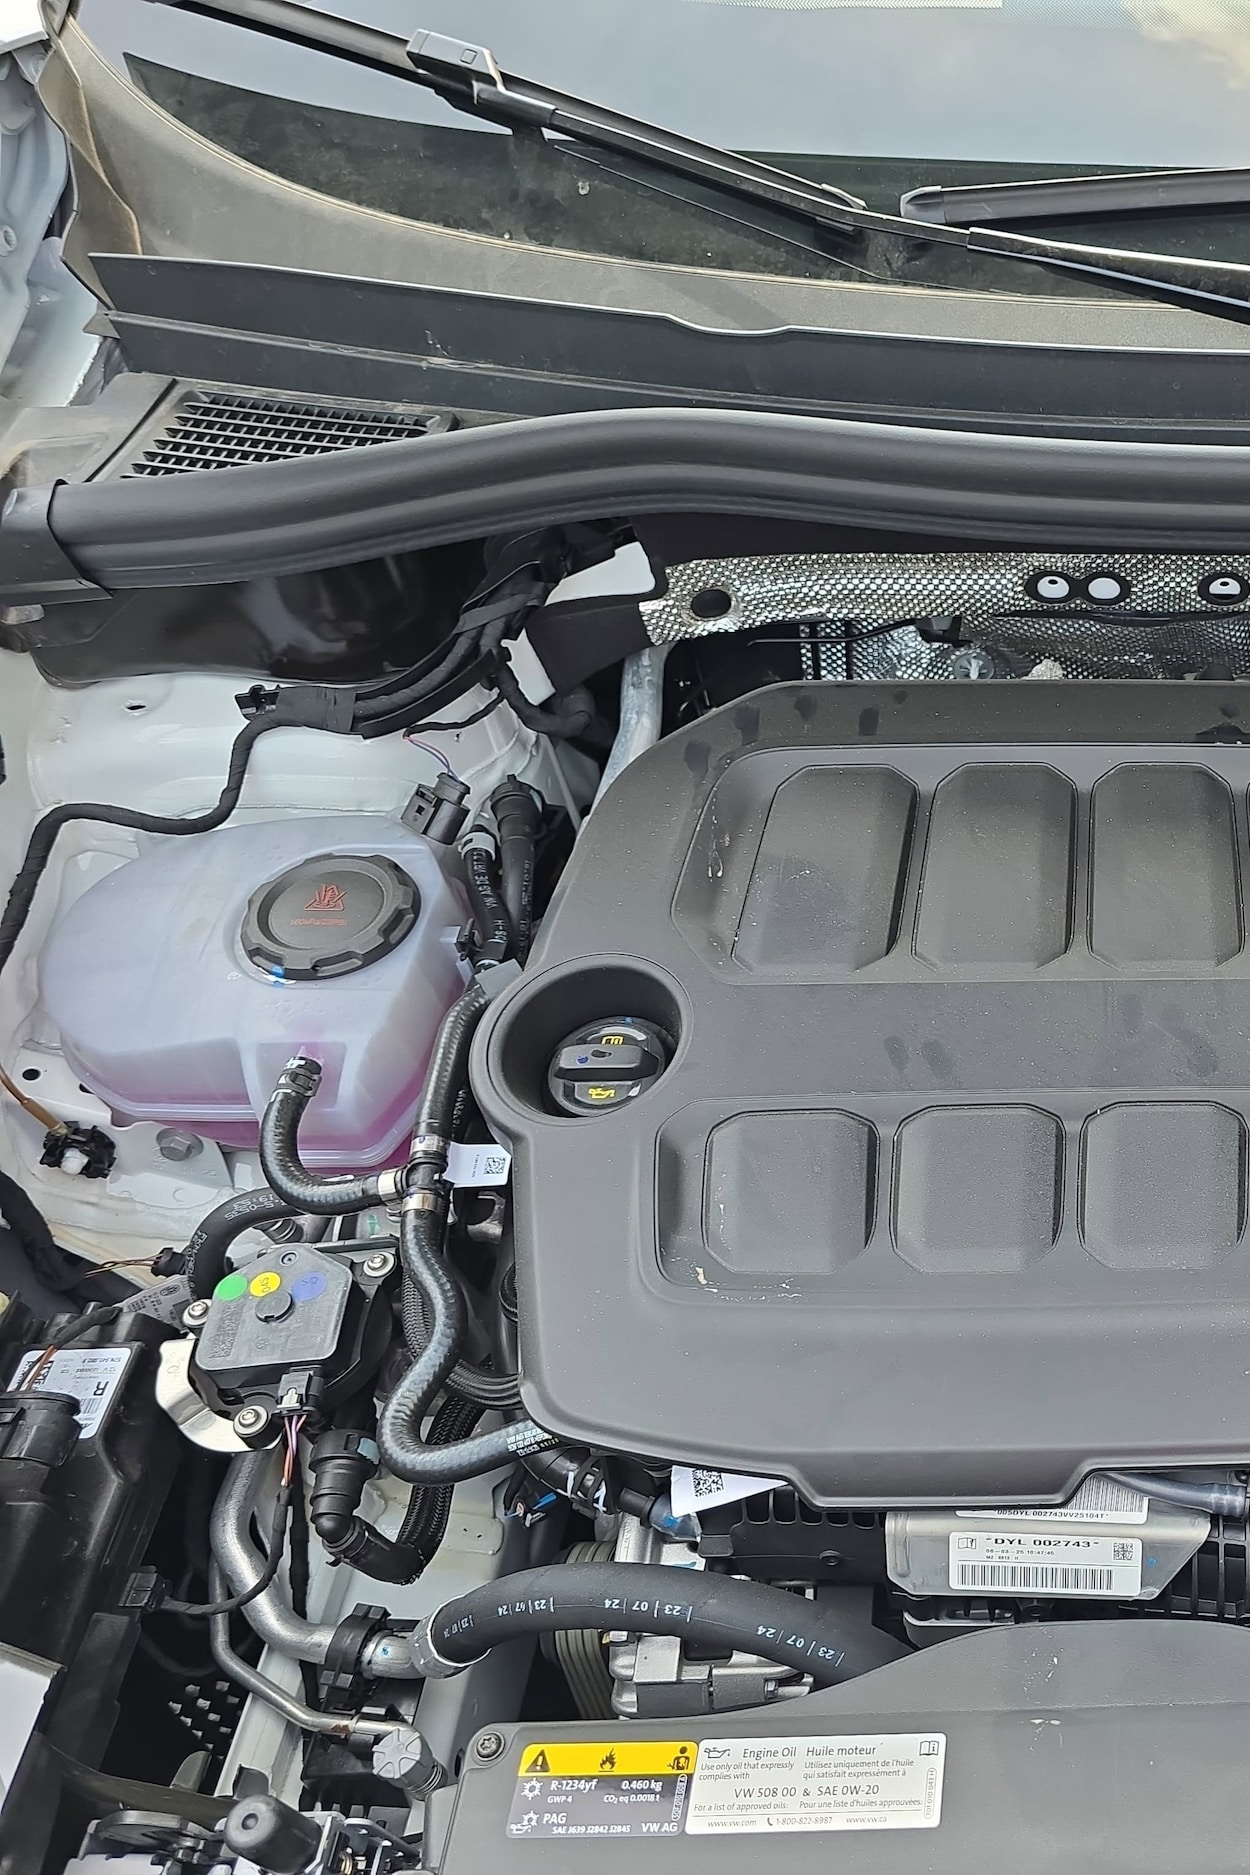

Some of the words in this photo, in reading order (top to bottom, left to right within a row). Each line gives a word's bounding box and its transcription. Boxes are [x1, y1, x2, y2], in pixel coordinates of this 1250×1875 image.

[93, 1381, 109, 1396] R
[534, 1599, 546, 1609] 23
[604, 1597, 620, 1610] 24
[632, 1600, 649, 1612] 07
[664, 1604, 682, 1616] 23
[756, 1624, 776, 1638] 24
[786, 1634, 805, 1648] 07
[817, 1645, 836, 1660] 23
[743, 1747, 779, 1761] Engine
[782, 1747, 796, 1757] Oil
[806, 1746, 834, 1757] Huile
[837, 1746, 877, 1756] moteur
[701, 1763, 715, 1771] Use
[716, 1762, 732, 1771] only
[761, 1761, 794, 1771] expressly
[804, 1761, 832, 1769] Utilisez
[834, 1760, 879, 1771] uniquement
[881, 1759, 890, 1767] de
[699, 1773, 732, 1782] complies
[803, 1771, 816, 1779] qui
[816, 1770, 846, 1778] satisfait
[848, 1769, 900, 1779] expressément
[550, 1779, 598, 1792] R-1234yf
[621, 1781, 649, 1790] 0.460
[650, 1780, 663, 1791] kg
[734, 1788, 755, 1798] VW
[757, 1787, 778, 1798] 508
[782, 1787, 796, 1797] 00
[803, 1788, 811, 1796] &
[817, 1785, 838, 1796] SAE
[841, 1785, 879, 1795] 0W-20
[714, 1803, 725, 1811] list
[736, 1802, 772, 1812] approved
[773, 1801, 789, 1810] oils:
[799, 1800, 818, 1809] Pour
[819, 1800, 832, 1808] une
[834, 1799, 849, 1807] liste
[542, 1813, 567, 1824] PAG
[708, 1819, 757, 1827] www.vw.com
[552, 1826, 568, 1834] SAE
[642, 1822, 660, 1832] VW
[662, 1822, 678, 1832] AG
